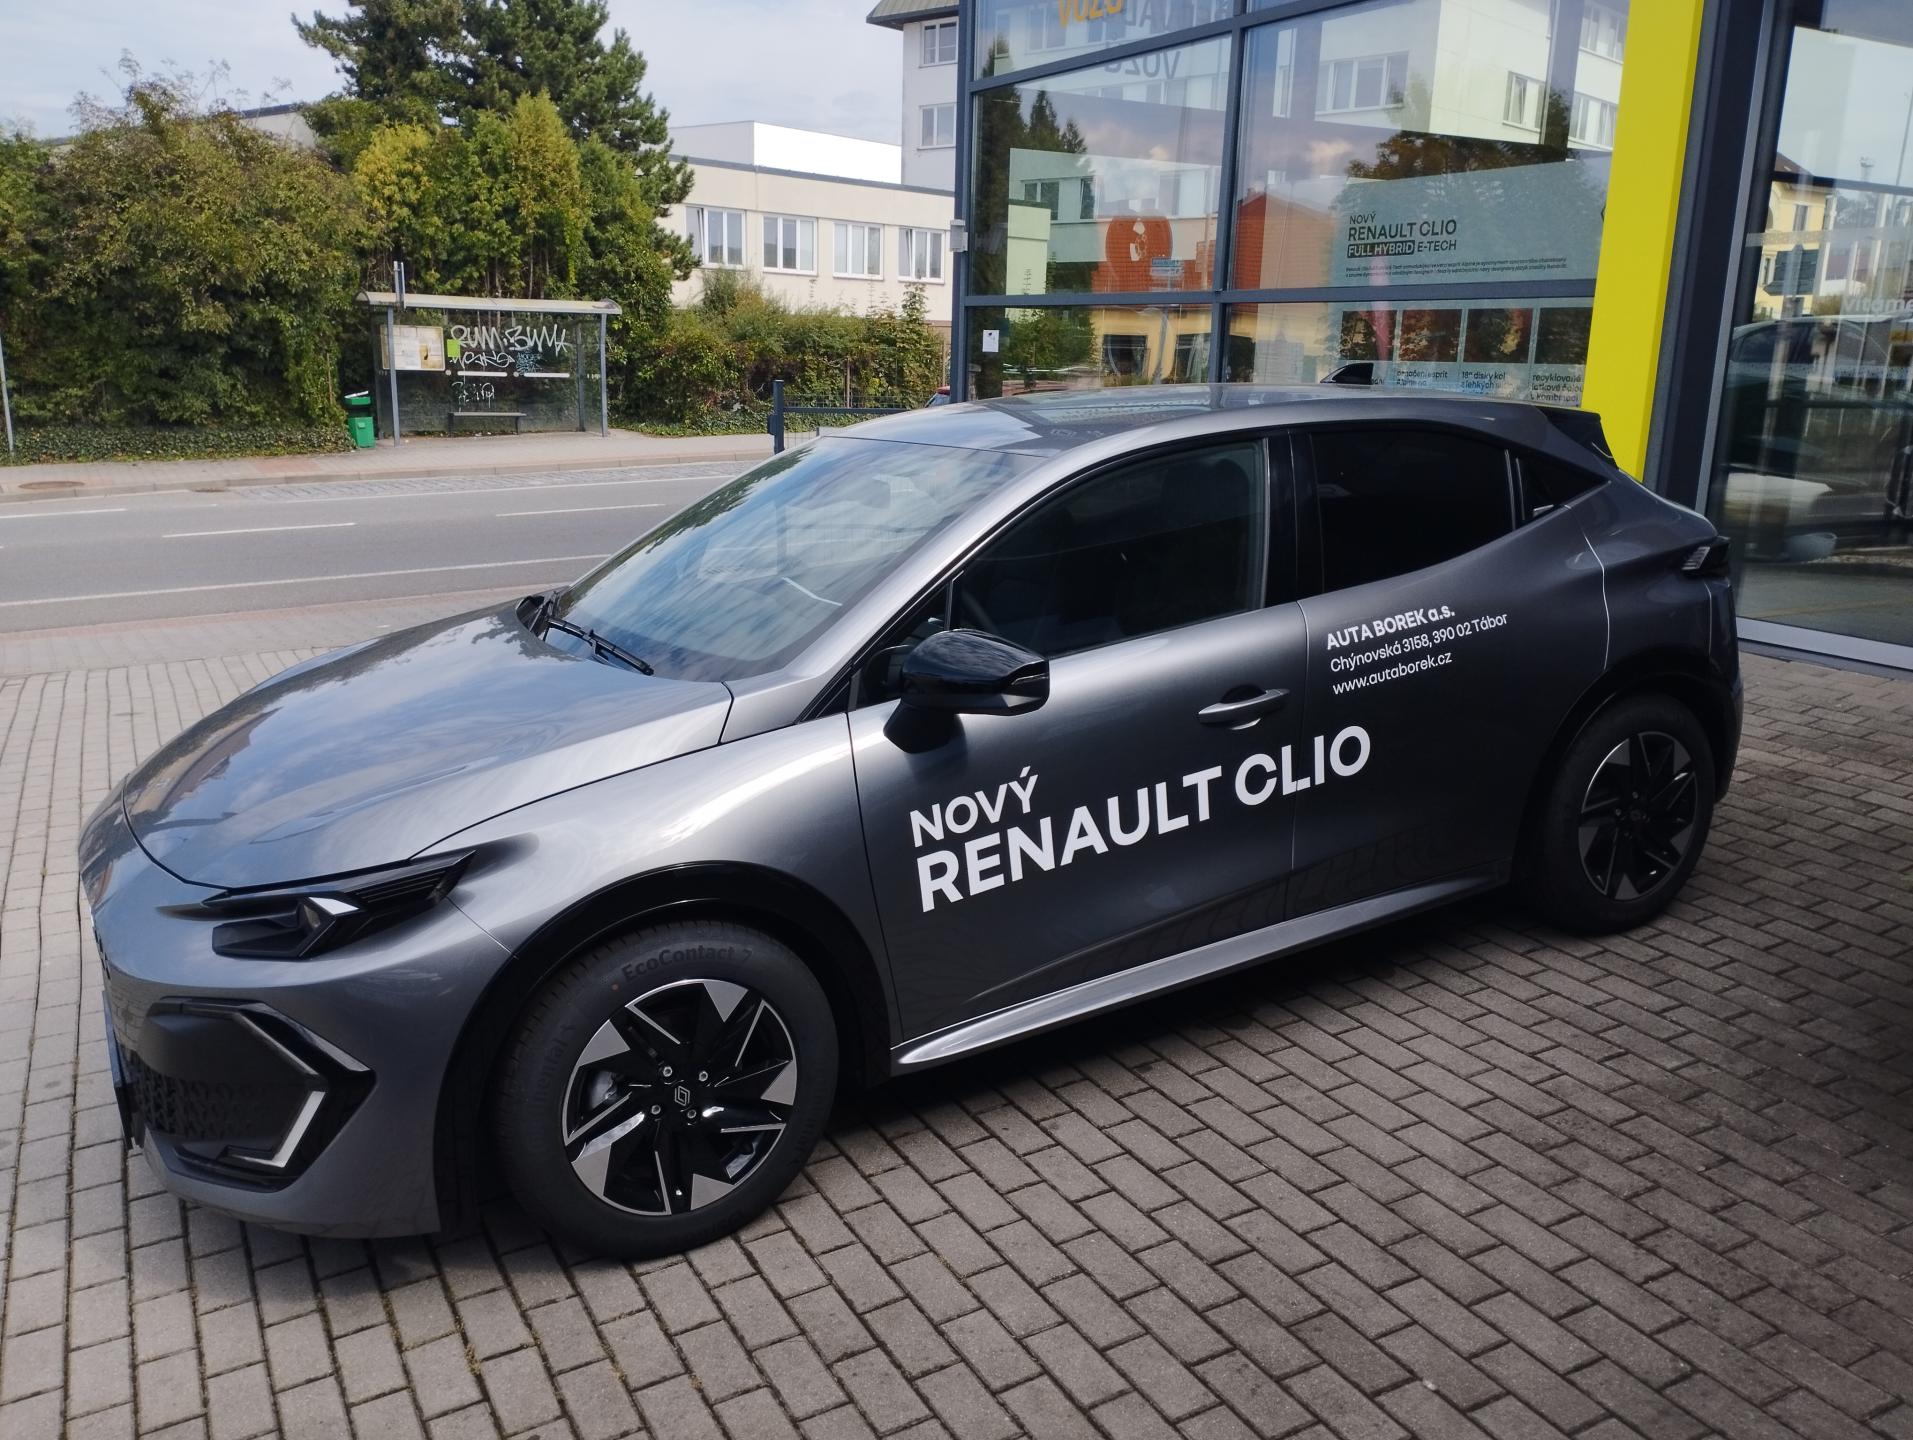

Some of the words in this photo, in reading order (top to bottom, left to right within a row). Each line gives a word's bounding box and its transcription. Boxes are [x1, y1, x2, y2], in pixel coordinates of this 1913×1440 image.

[1347, 222, 1417, 241] RENAULT
[1419, 219, 1457, 237] CLIO
[1349, 211, 1376, 225] NOVÝ
[1348, 244, 1373, 257] FULL
[1374, 241, 1414, 256] HYBRID
[1417, 240, 1457, 252] E-TECH
[1327, 623, 1374, 650] AUTA
[1372, 608, 1429, 637] BOREK
[1427, 605, 1456, 622] a.s.
[1330, 641, 1402, 672] Chýnovská
[1402, 633, 1433, 653] 3158,
[1432, 626, 1455, 644] 390
[1456, 622, 1473, 637] 02
[1471, 613, 1508, 633] Tábor
[1332, 652, 1453, 695] www.autaborek.cz
[909, 765, 1039, 848] NOVÝ
[916, 765, 1223, 913] RENAULT
[1234, 725, 1371, 806] CLIO
[621, 944, 735, 982] EcoContact
